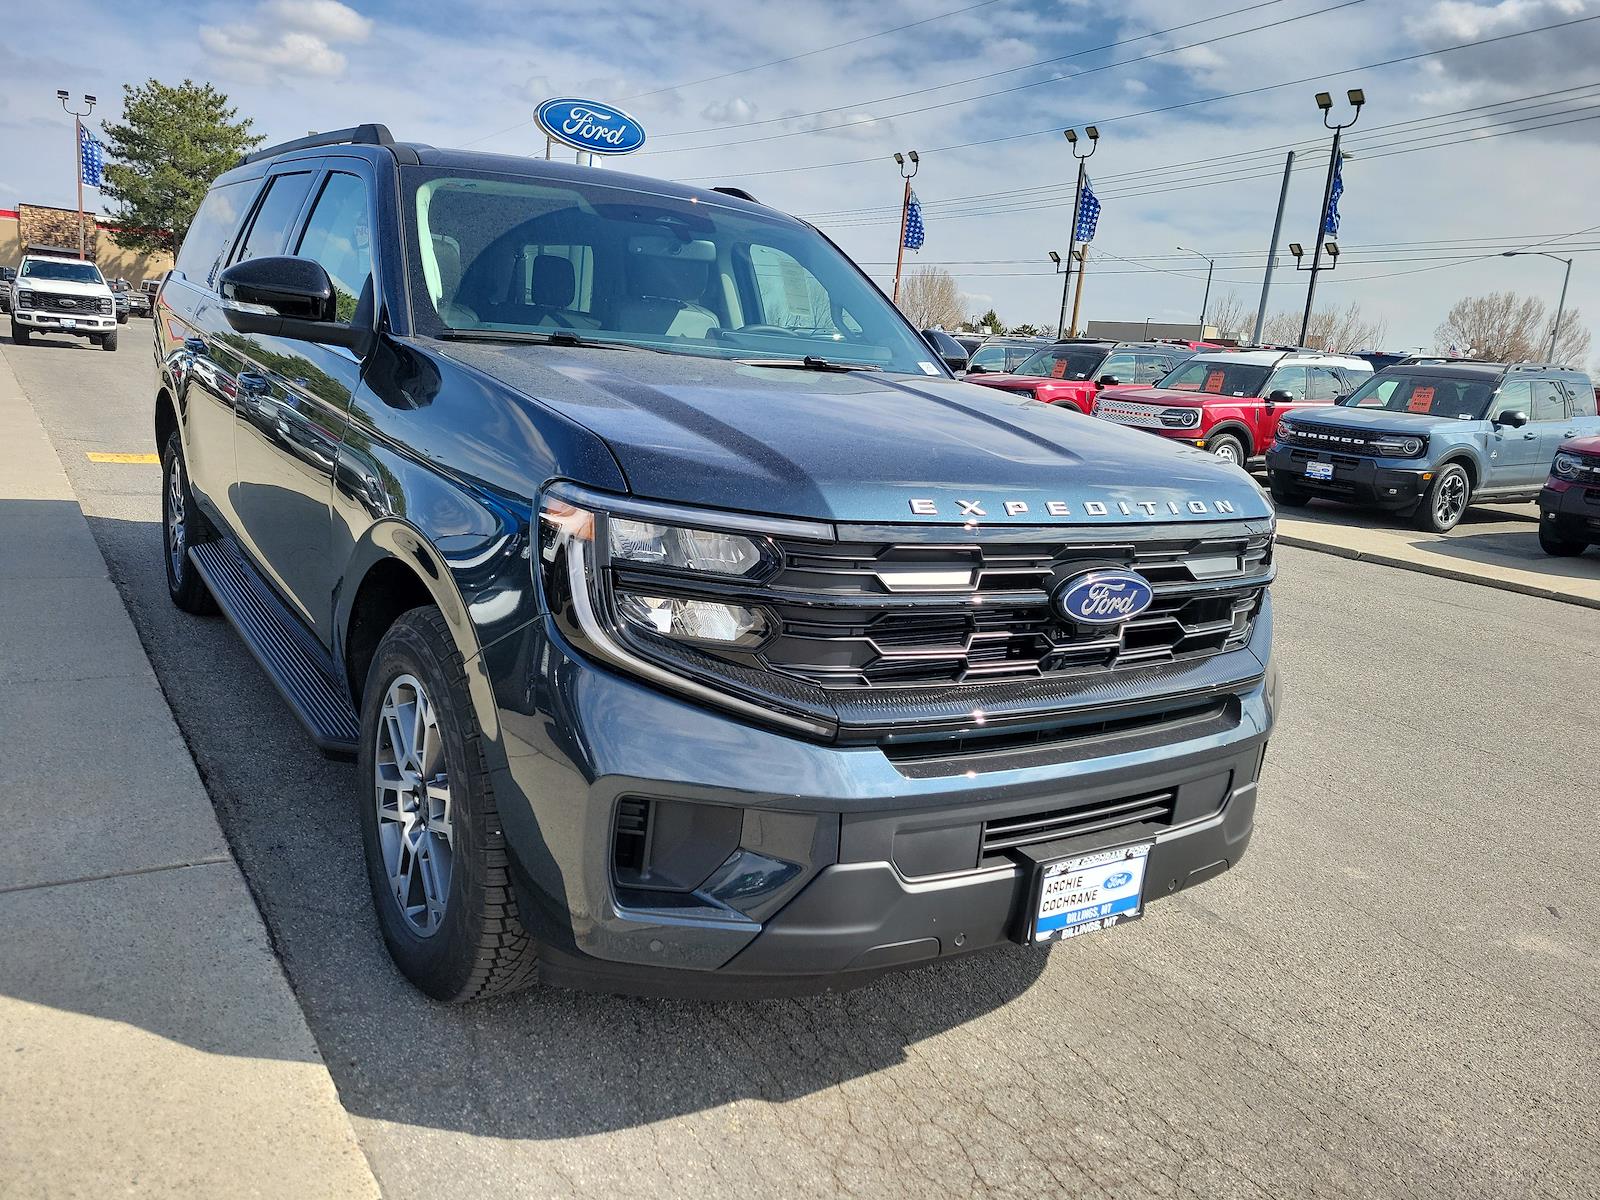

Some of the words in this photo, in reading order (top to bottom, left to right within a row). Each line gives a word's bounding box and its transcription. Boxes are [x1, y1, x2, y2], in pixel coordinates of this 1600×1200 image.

[562, 107, 627, 146] Ford
[1103, 407, 1151, 417] BRONCO
[1297, 431, 1365, 445] BRONCO
[908, 498, 1236, 517] EXPEDITION
[1080, 583, 1136, 616] Ford
[1045, 876, 1084, 896] ARCHIE
[1042, 889, 1099, 912] COCHRANE
[1100, 903, 1114, 916] MT
[1103, 915, 1119, 928] MT
